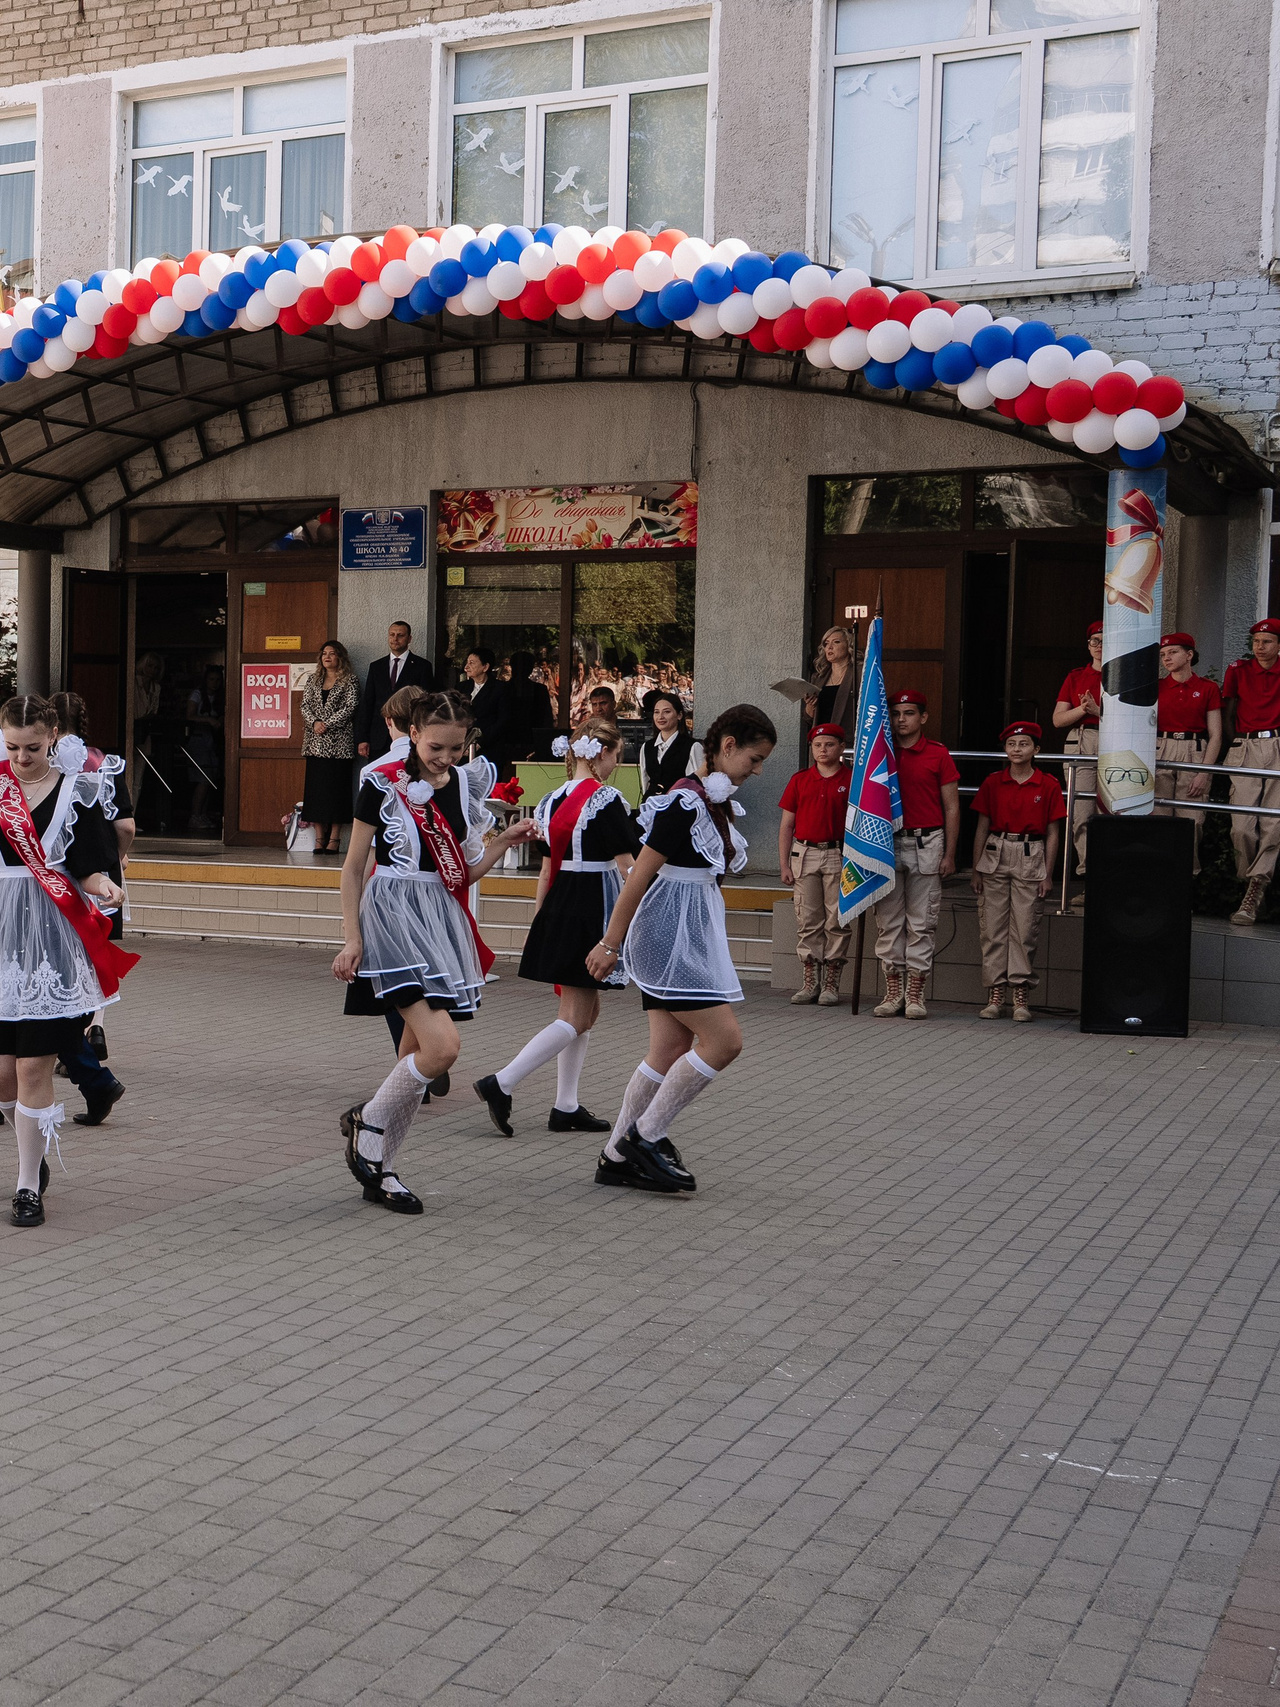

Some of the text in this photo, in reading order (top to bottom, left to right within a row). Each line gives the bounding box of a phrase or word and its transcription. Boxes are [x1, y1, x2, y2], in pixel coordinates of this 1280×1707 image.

[508, 499, 626, 525] До свидания,
[505, 526, 571, 544] ШКОЛА!
[246, 674, 287, 688] ВХОД
[251, 694, 280, 710] №1
[247, 718, 286, 728] 1 этаж
